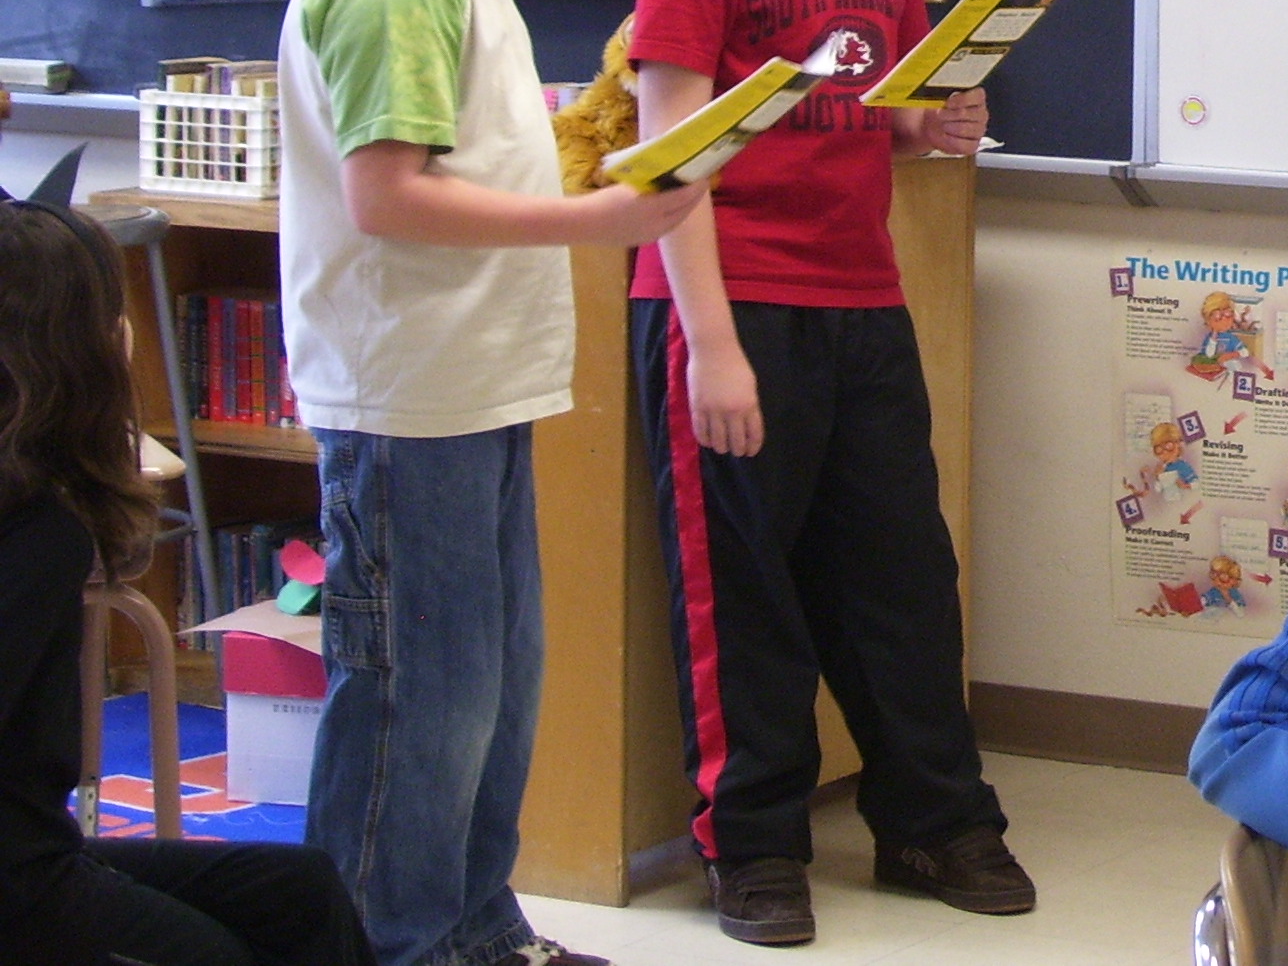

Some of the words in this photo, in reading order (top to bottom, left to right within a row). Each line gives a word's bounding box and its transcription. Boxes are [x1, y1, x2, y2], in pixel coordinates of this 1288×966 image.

[1126, 257, 1169, 281] The
[1175, 260, 1271, 293] Writing
[1126, 294, 1180, 309] Prewriting
[1203, 440, 1244, 453] Revising
[1125, 525, 1190, 542] Proofreading
